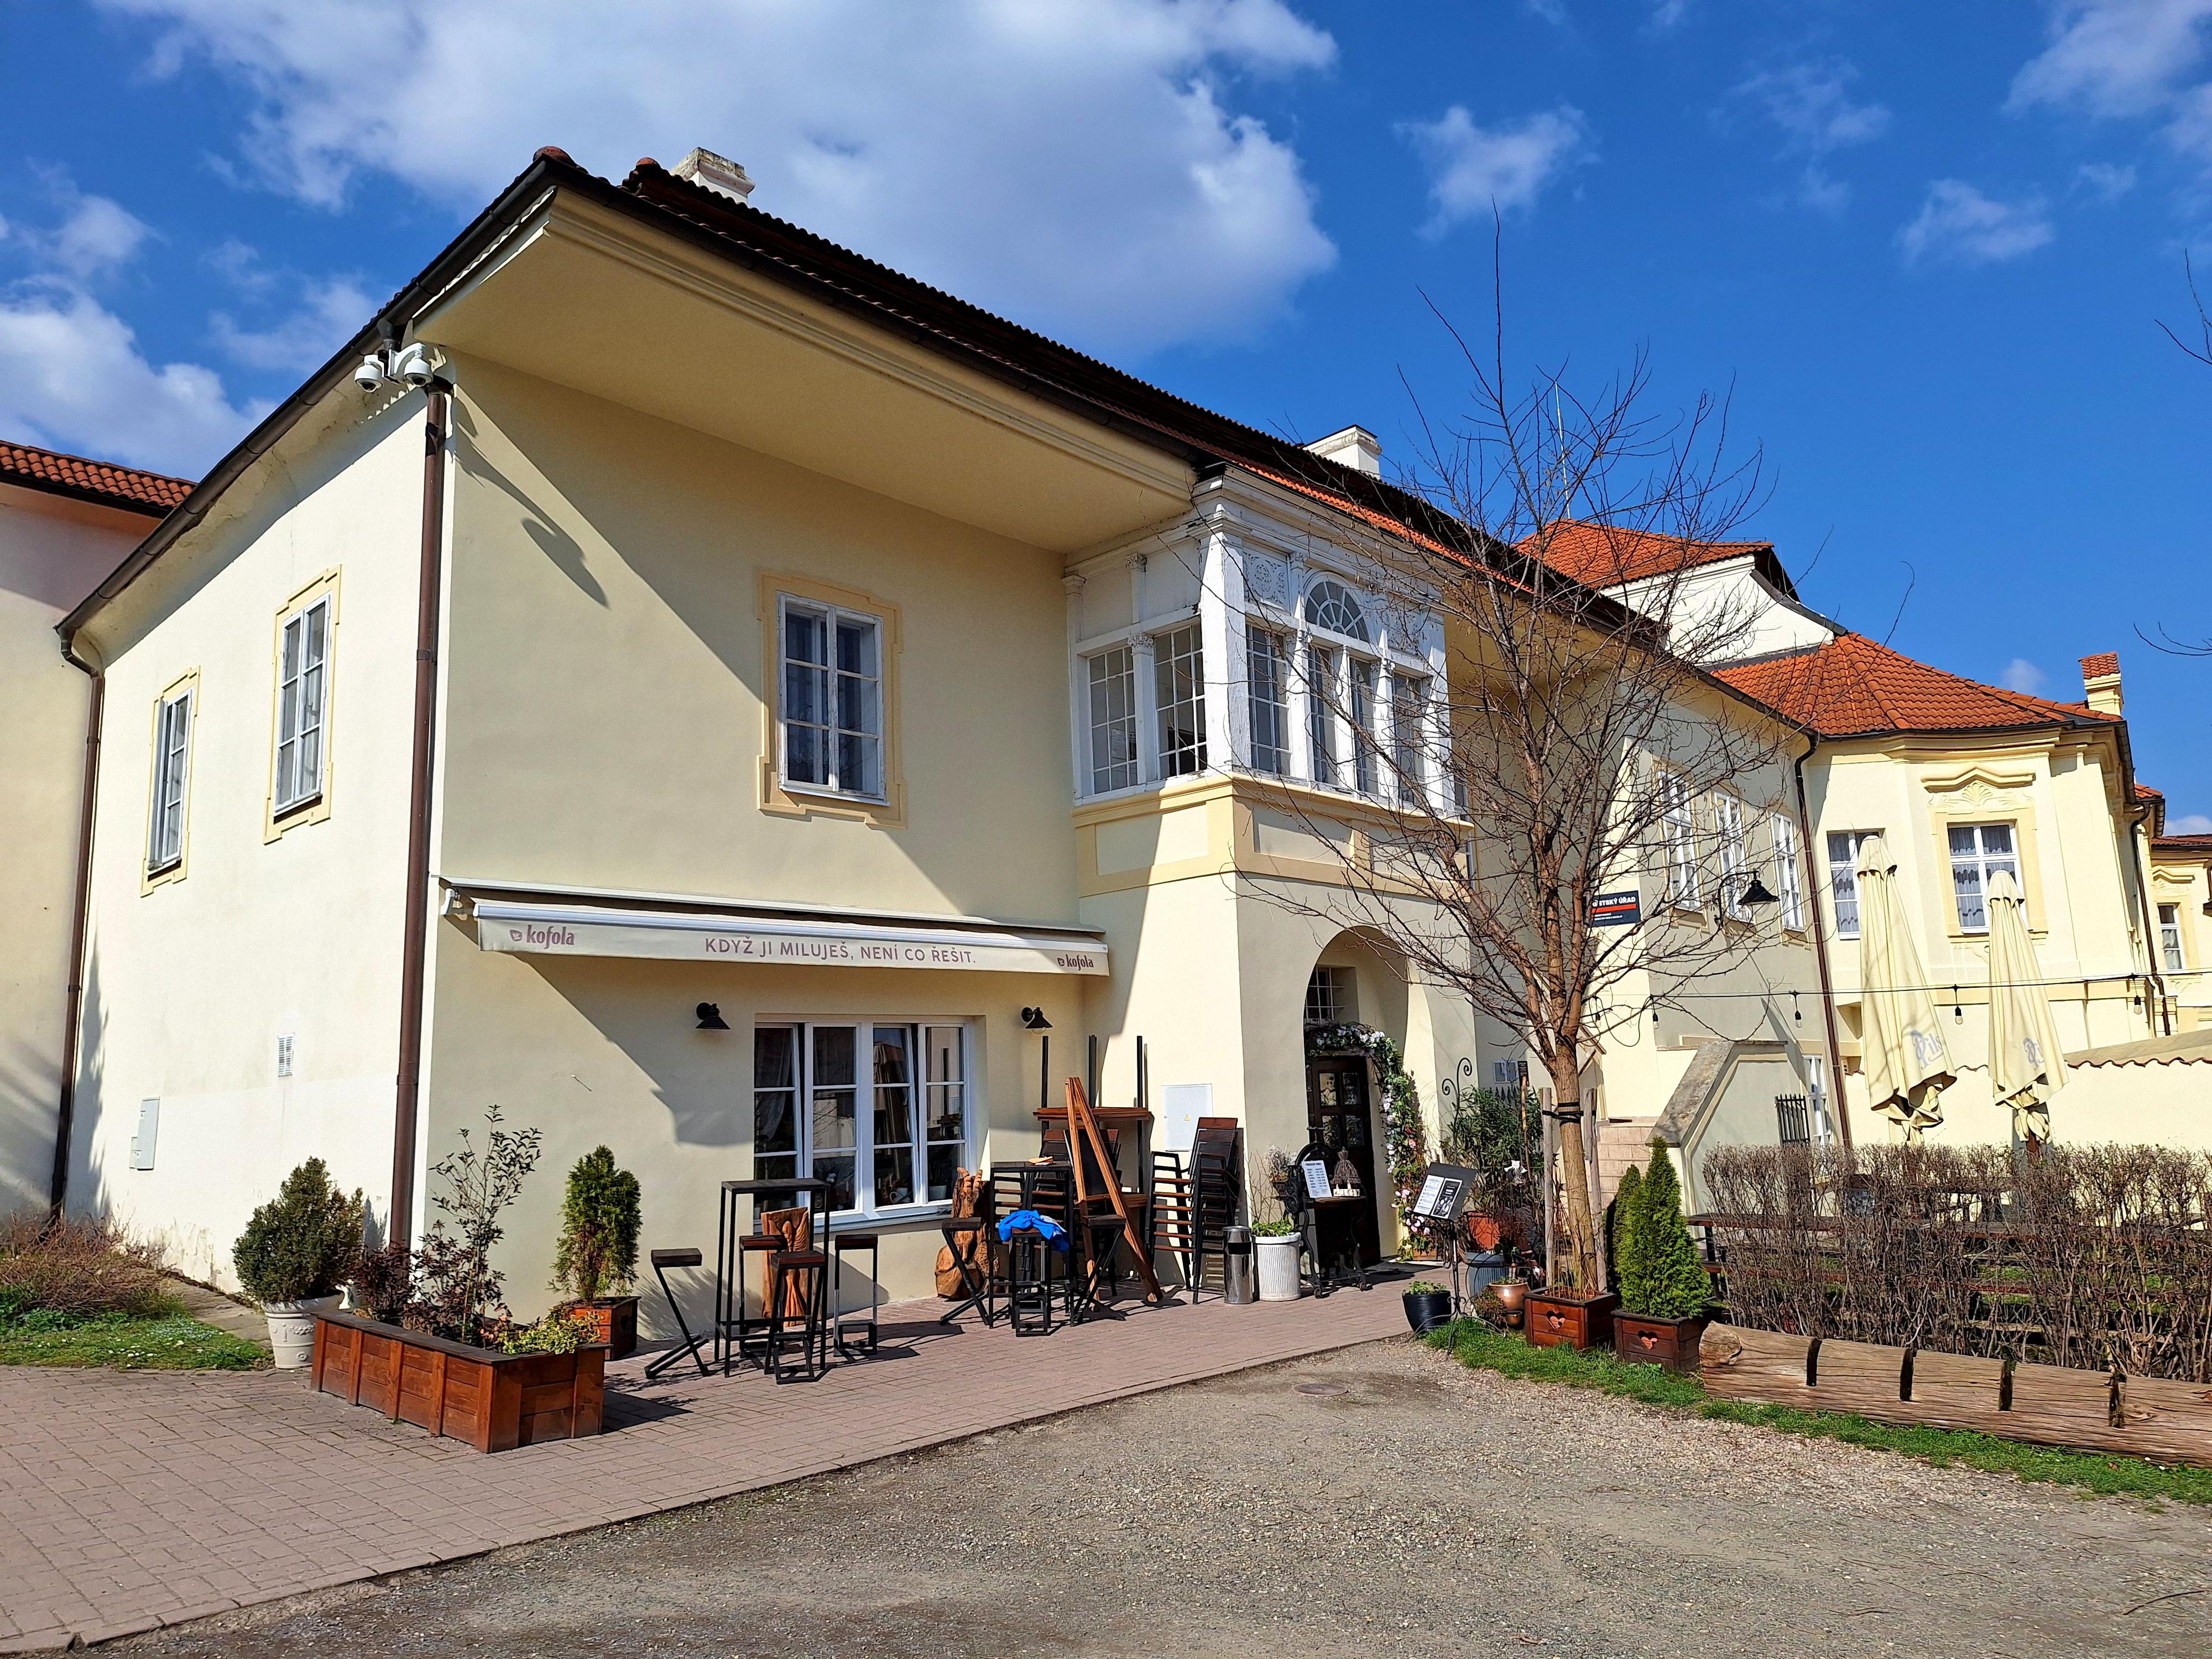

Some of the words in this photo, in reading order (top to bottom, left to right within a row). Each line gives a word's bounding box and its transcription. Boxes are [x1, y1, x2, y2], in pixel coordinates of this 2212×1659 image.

[1618, 896, 1636, 904] ÚŘAD
[526, 924, 575, 949] kofola
[705, 936, 753, 954] KDYŽ
[759, 941, 772, 957] JI
[780, 941, 854, 960] MILUJEŠ,
[860, 944, 898, 960] NENÍ
[905, 948, 925, 961] CO
[931, 946, 976, 963] ŘEŠIT.
[1065, 954, 1094, 971] kofola
